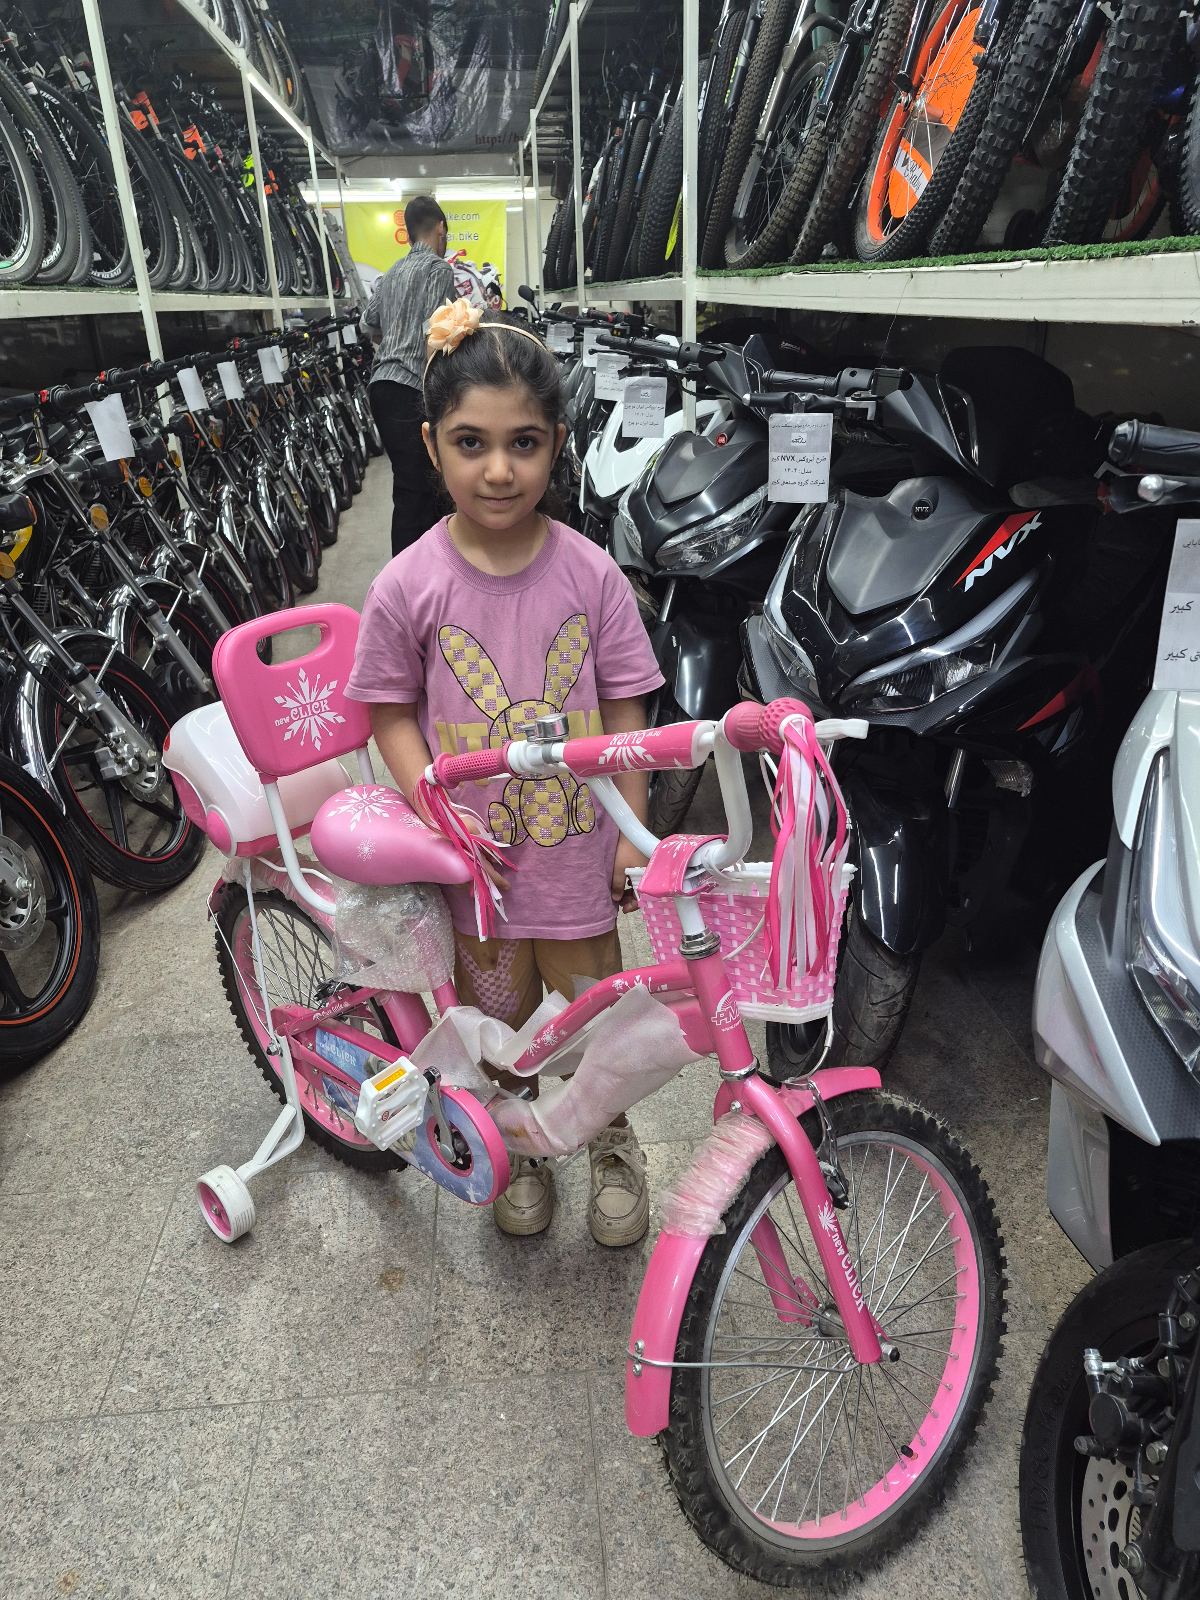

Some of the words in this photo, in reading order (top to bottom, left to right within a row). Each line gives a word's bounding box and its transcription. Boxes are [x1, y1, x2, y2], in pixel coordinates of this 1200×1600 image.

[964, 511, 1043, 593] NVX
[1168, 600, 1195, 614] کبیر
[1163, 647, 1189, 662] کبیر
[274, 716, 290, 727] new
[290, 699, 331, 721] CLICK
[831, 1231, 846, 1257] new
[841, 1252, 867, 1314] CLICK
